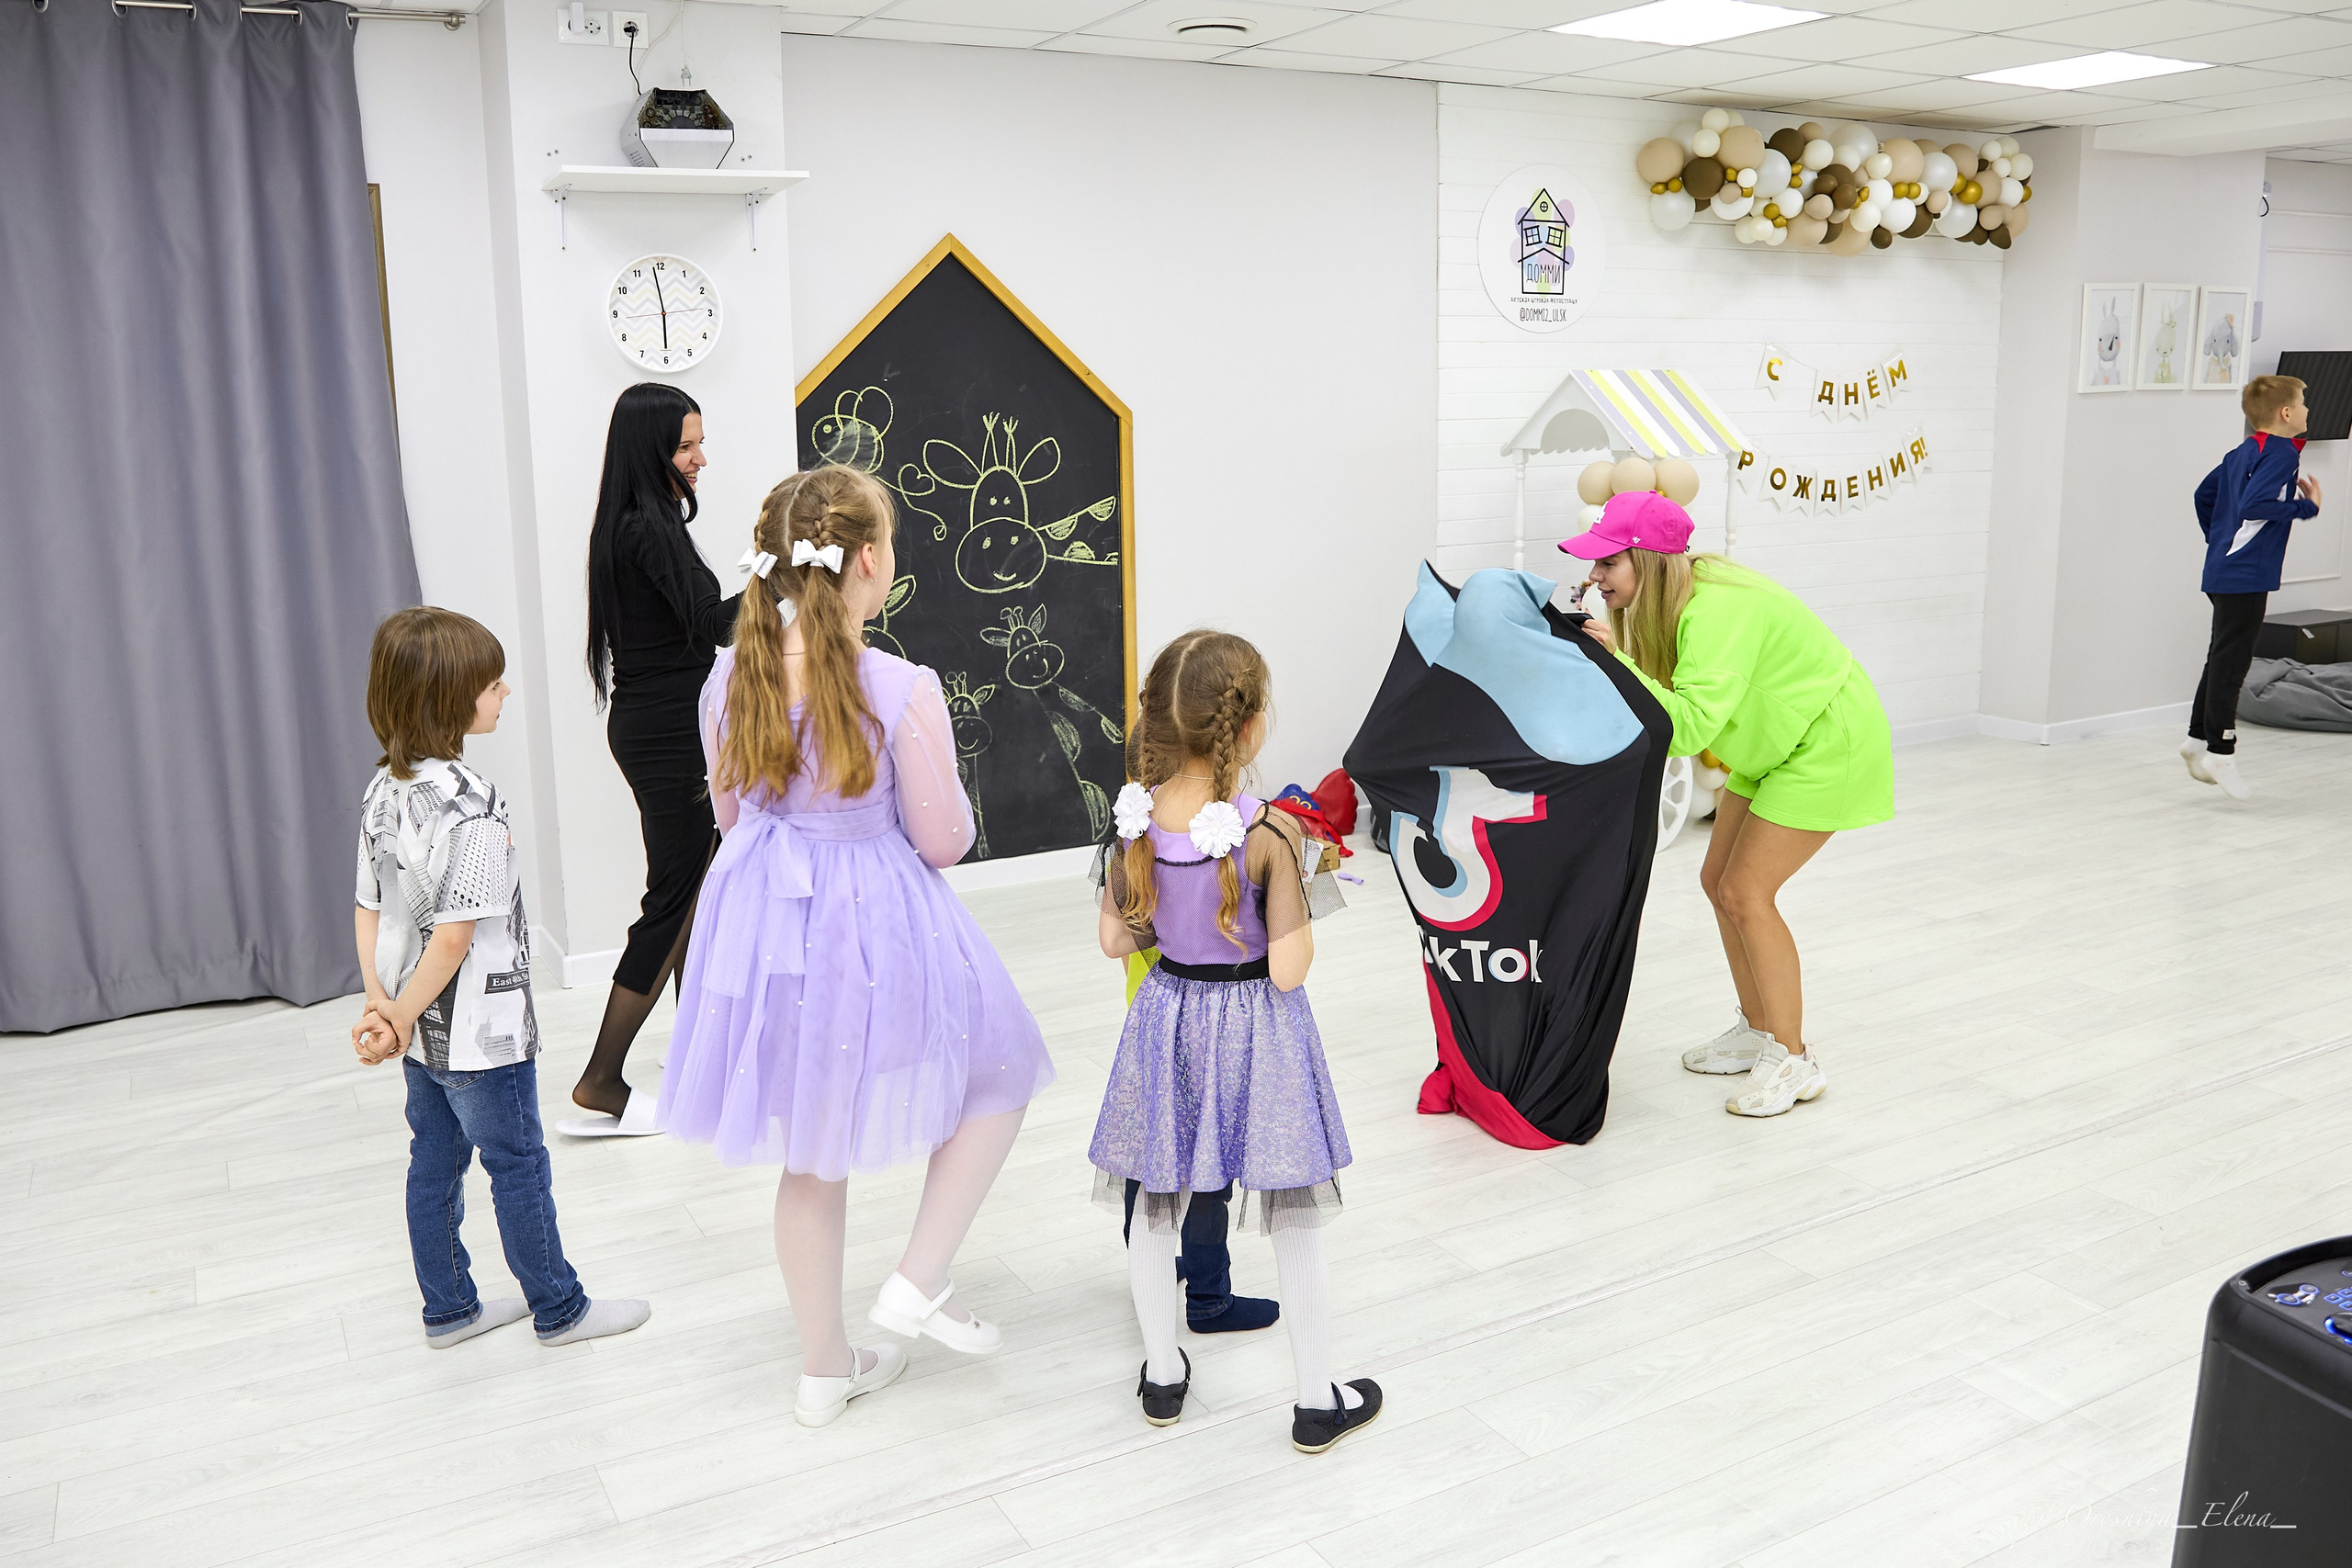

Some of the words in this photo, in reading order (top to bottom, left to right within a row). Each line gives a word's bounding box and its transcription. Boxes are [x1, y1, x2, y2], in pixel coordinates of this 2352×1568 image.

[656, 262, 665, 270] 12
[633, 269, 641, 277] 11
[1526, 263, 1561, 284] ДОММИ
[617, 287, 628, 295] 10
[699, 287, 705, 295] 2
[613, 310, 618, 319] 9
[621, 333, 627, 342] 8
[639, 350, 645, 358] 7
[663, 356, 669, 365] 6
[1767, 357, 1783, 381] С
[1817, 359, 1907, 406] ДНЁМ
[1736, 436, 1928, 502] РОЖДЕНИЯ!
[492, 977, 512, 987] East
